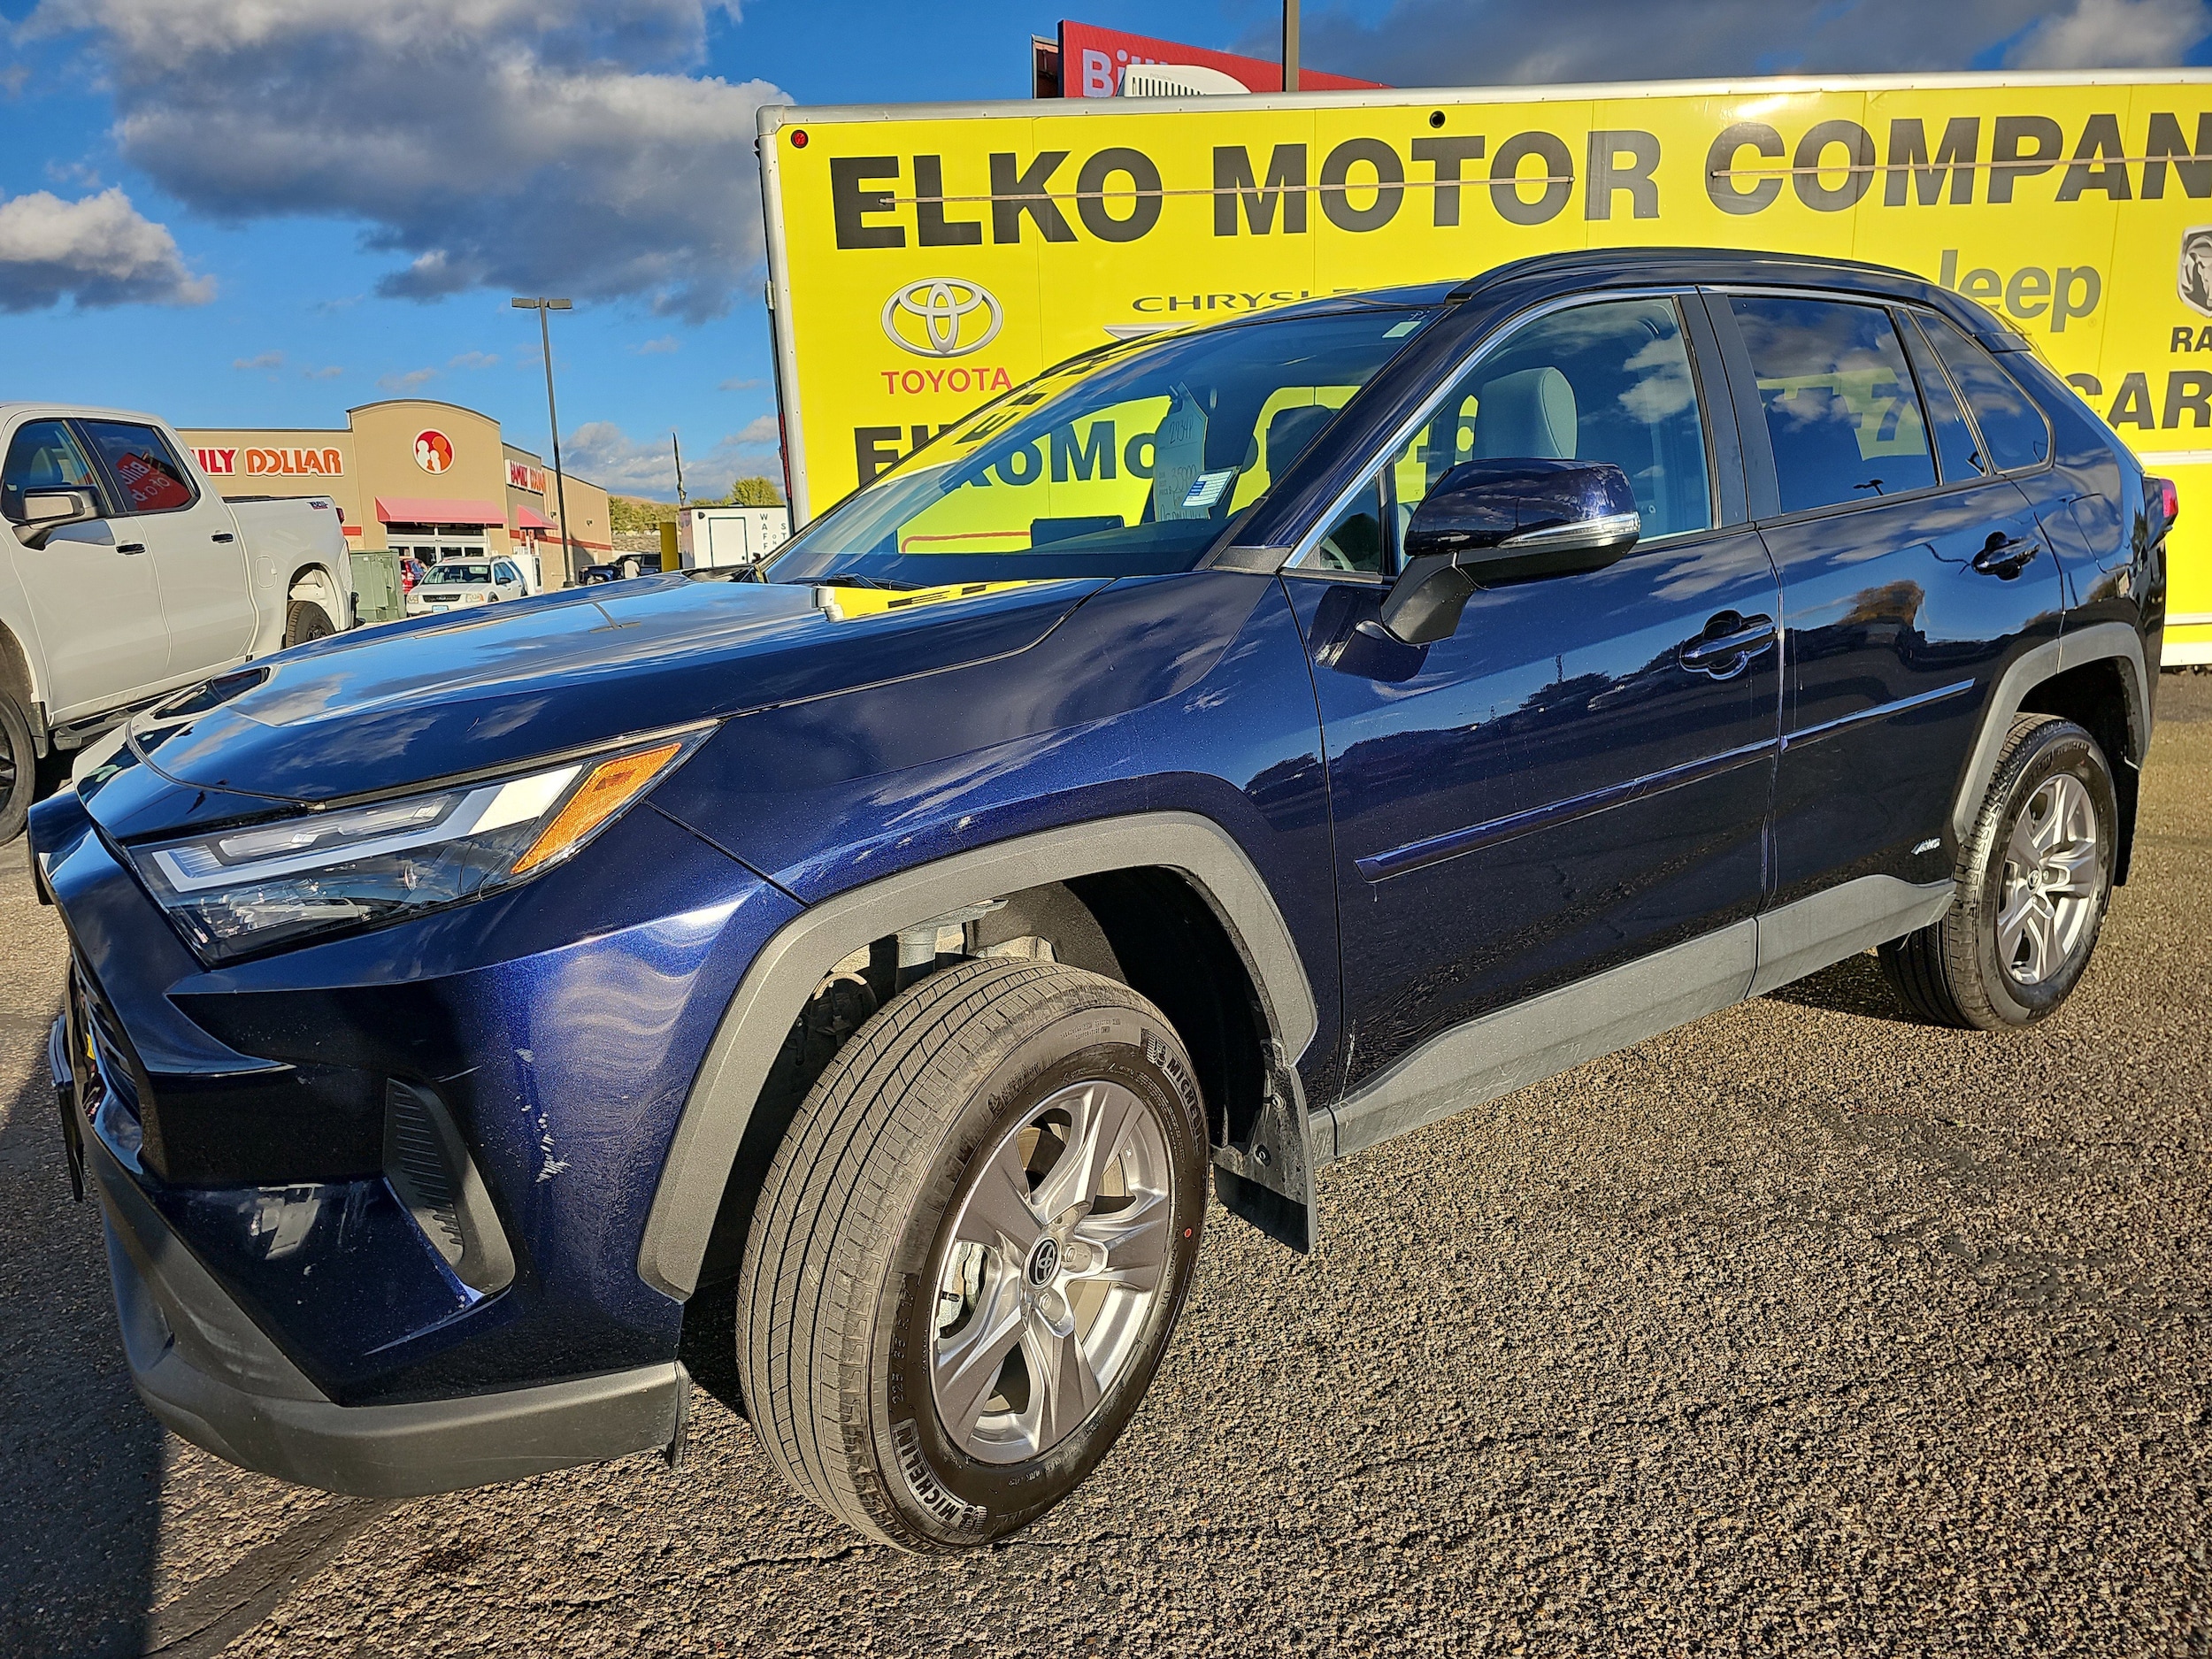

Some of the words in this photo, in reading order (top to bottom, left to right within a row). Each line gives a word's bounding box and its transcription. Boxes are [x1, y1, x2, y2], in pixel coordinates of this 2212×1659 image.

[830, 148, 1163, 250] ELKO
[1213, 130, 1660, 236] MOTOR
[1706, 112, 2212, 215] COMPAN
[1133, 288, 1358, 311] CHRYS
[881, 367, 1012, 395] TOYOTA
[189, 448, 236, 473] ILY
[245, 448, 342, 475] DOLLAR
[759, 512, 768, 557] WAFF
[895, 1425, 961, 1522] MICHELIN
